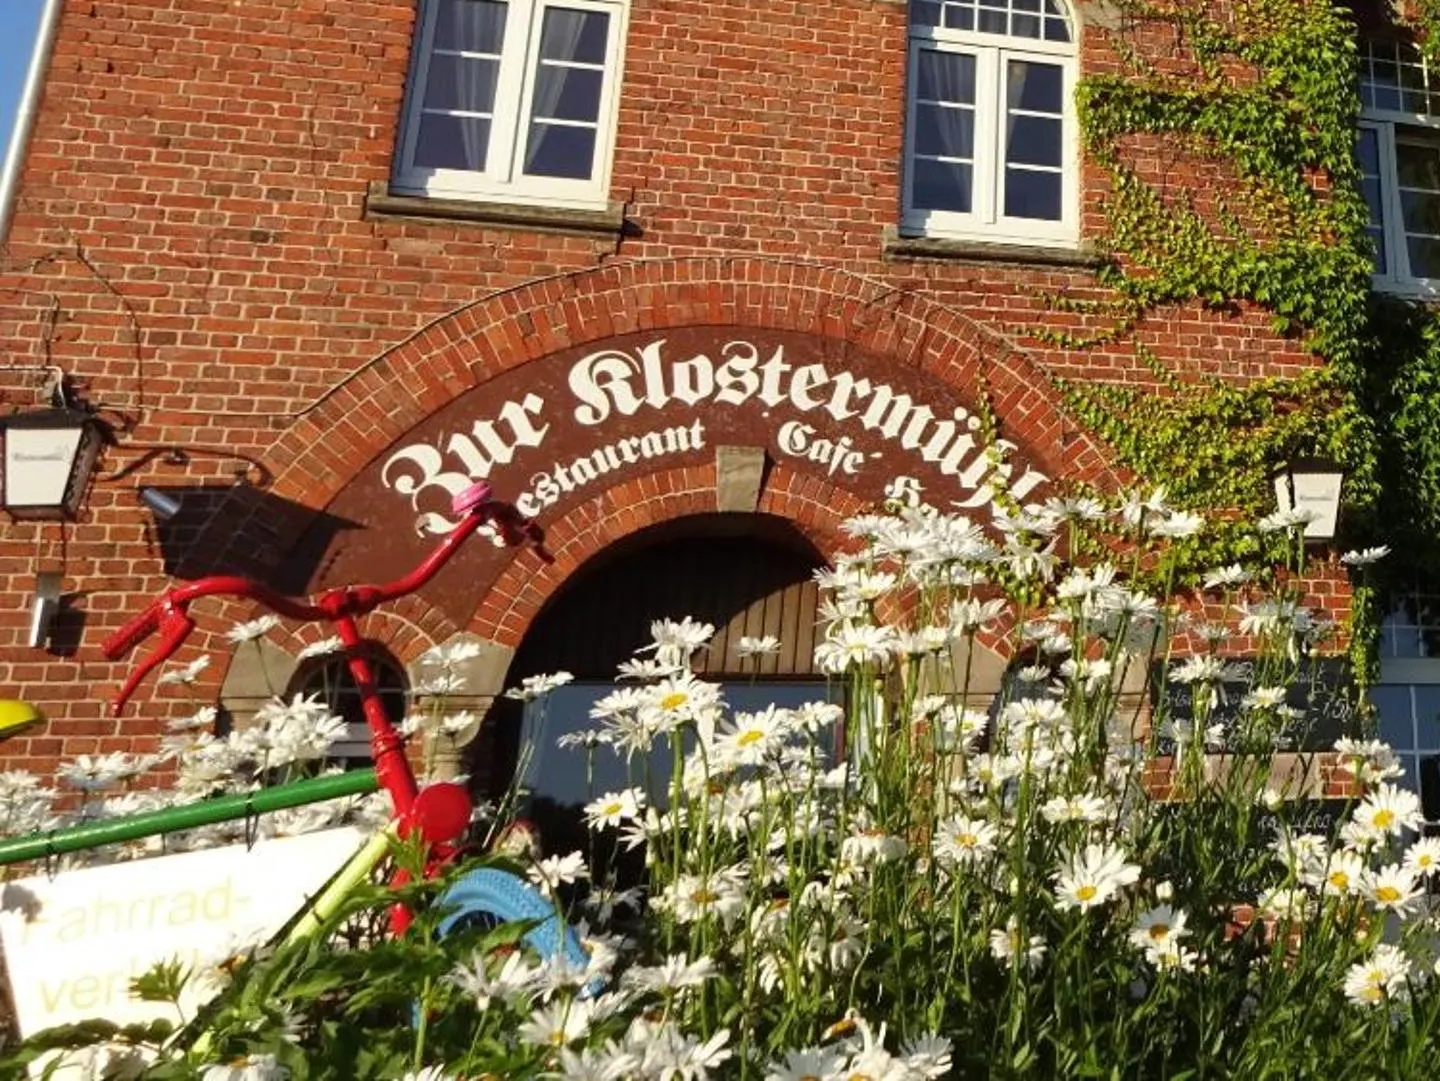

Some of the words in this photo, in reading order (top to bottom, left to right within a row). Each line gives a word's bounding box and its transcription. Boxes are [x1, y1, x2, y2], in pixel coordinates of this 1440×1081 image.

[381, 392, 550, 539] Zur
[567, 338, 1052, 520] Klostermühl
[476, 418, 706, 548] estaurant
